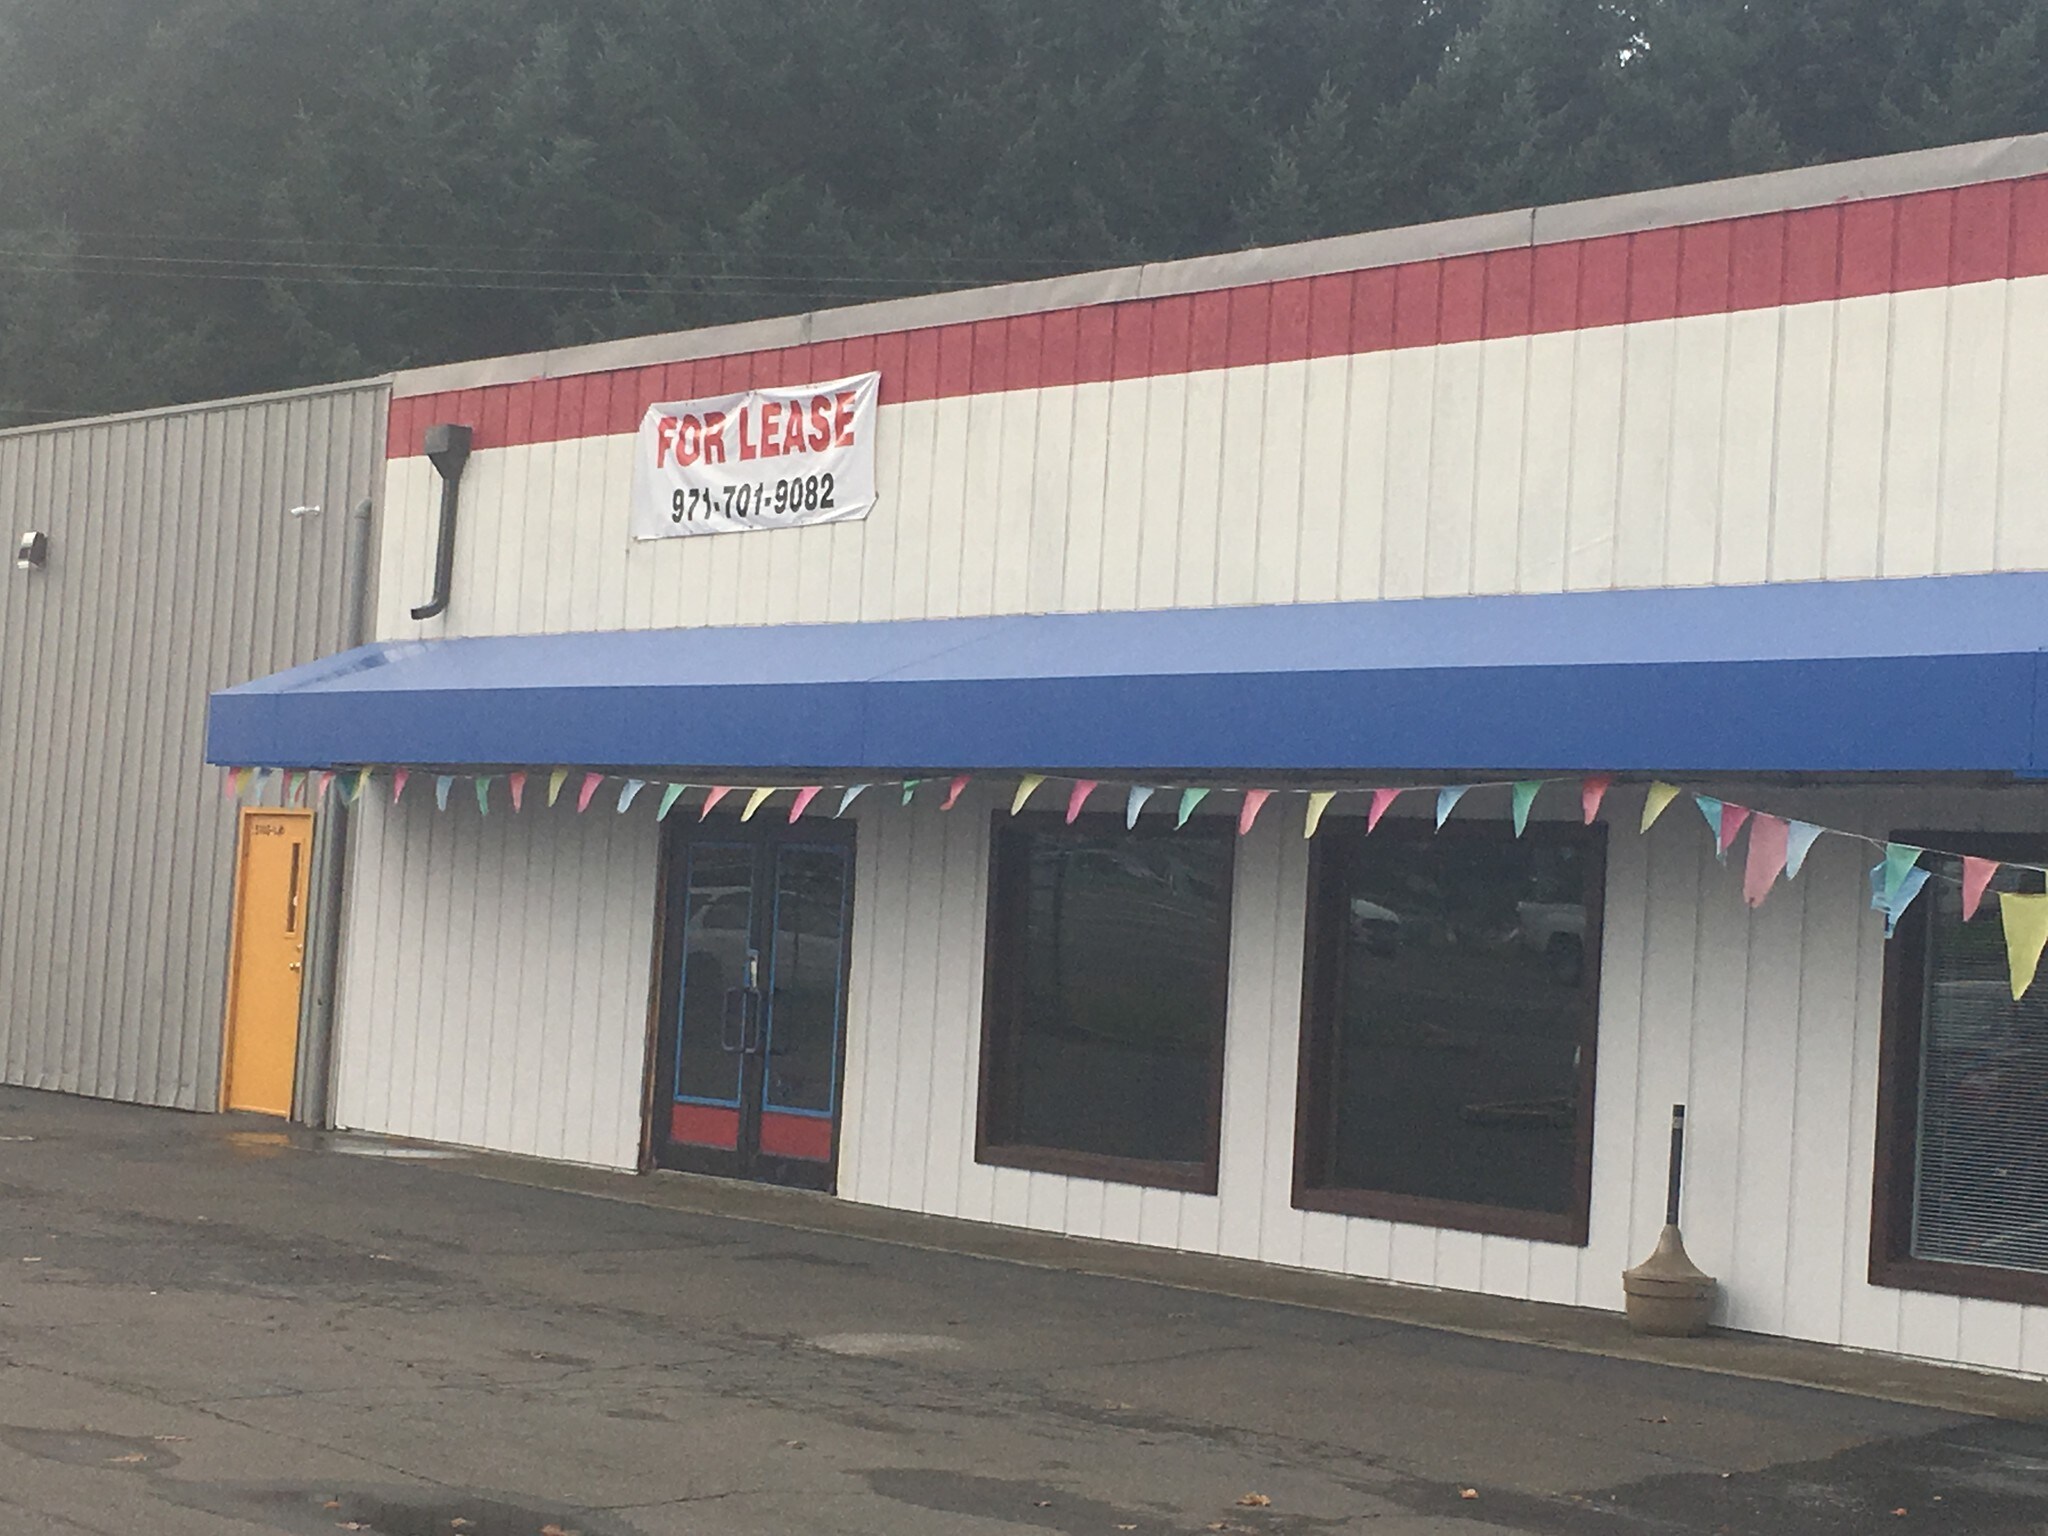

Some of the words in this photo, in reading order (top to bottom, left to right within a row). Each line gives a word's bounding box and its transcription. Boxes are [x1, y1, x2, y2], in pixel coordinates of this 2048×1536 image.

[656, 411, 727, 468] FOR
[739, 391, 857, 462] LEASE
[671, 472, 835, 523] 971-701-9082
